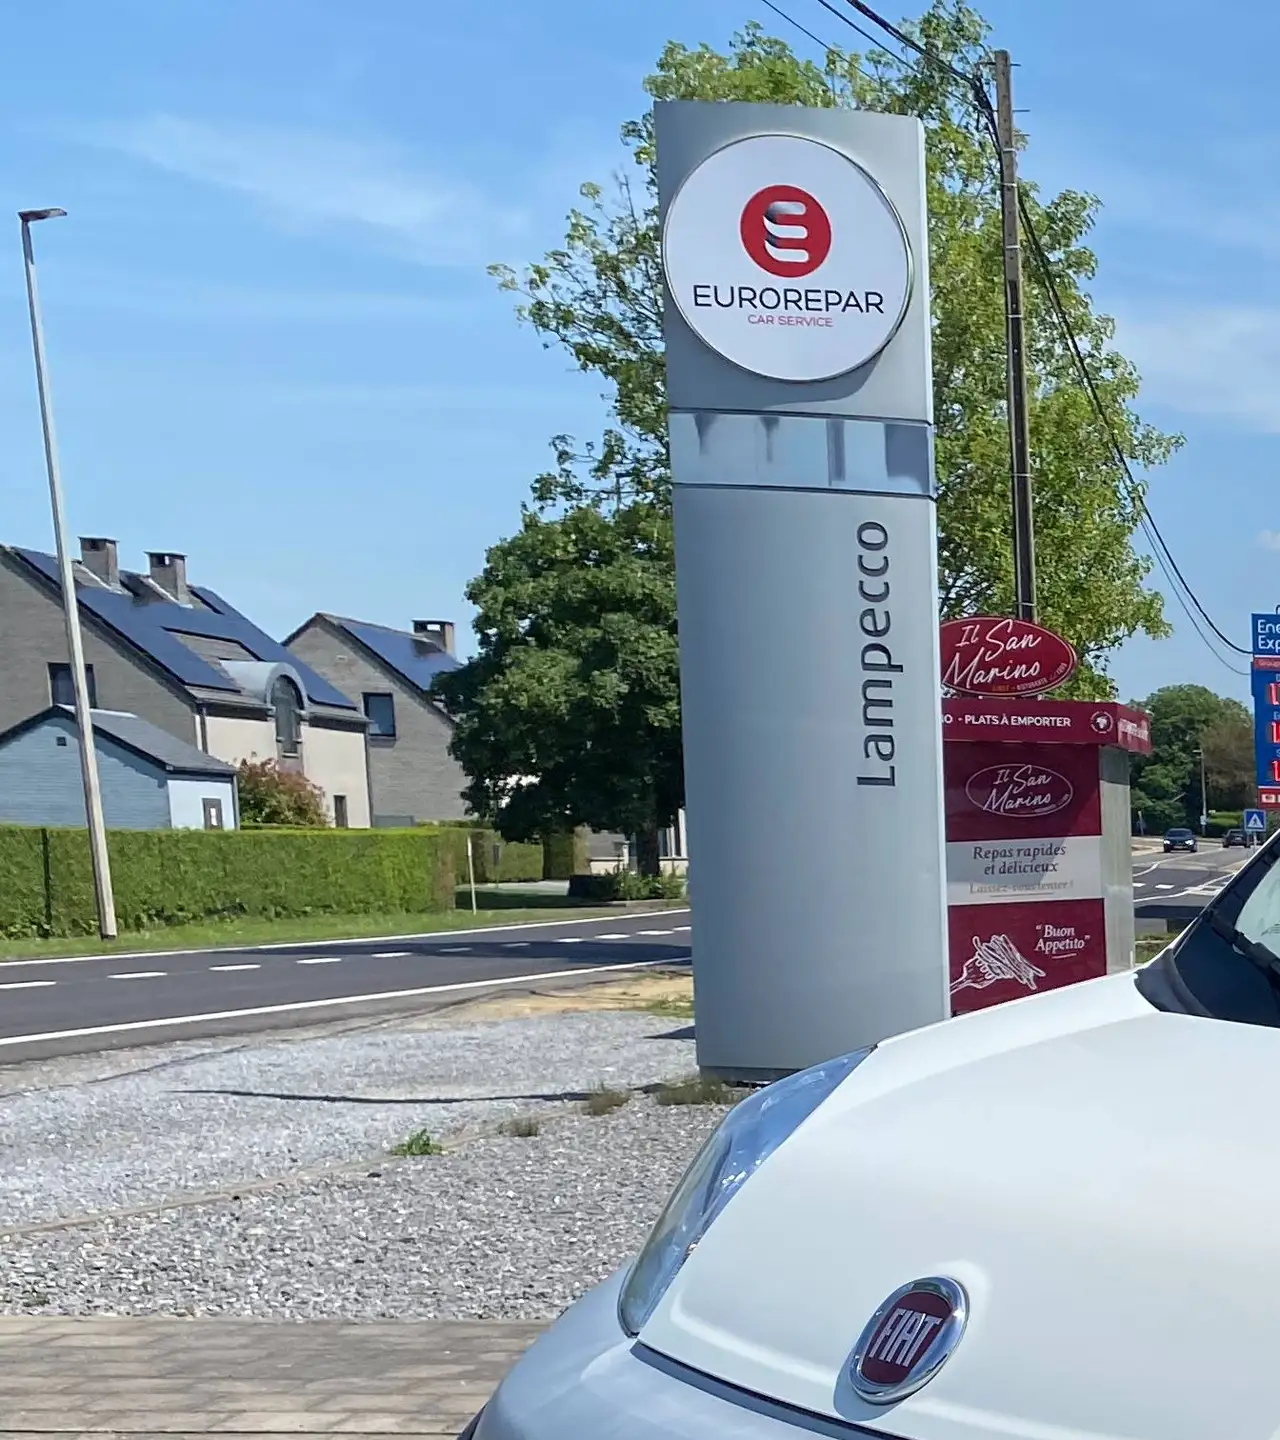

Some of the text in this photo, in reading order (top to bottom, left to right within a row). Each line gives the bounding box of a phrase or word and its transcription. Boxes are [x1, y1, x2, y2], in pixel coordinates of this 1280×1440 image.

[693, 284, 885, 314] EUROREPAR
[748, 314, 834, 327] CAR SERVICE
[856, 521, 903, 787] Lampecco
[955, 619, 1042, 662] Il San
[942, 647, 1041, 689] Marino
[964, 715, 999, 725] PLATS
[999, 713, 1009, 726] À
[1011, 716, 1071, 727] EMPORTER
[1013, 765, 1052, 794] San
[983, 784, 1051, 813] Marino
[973, 843, 1067, 861] Repas rapides
[984, 862, 1059, 875] et délicieux
[868, 1308, 944, 1367] FIAT
